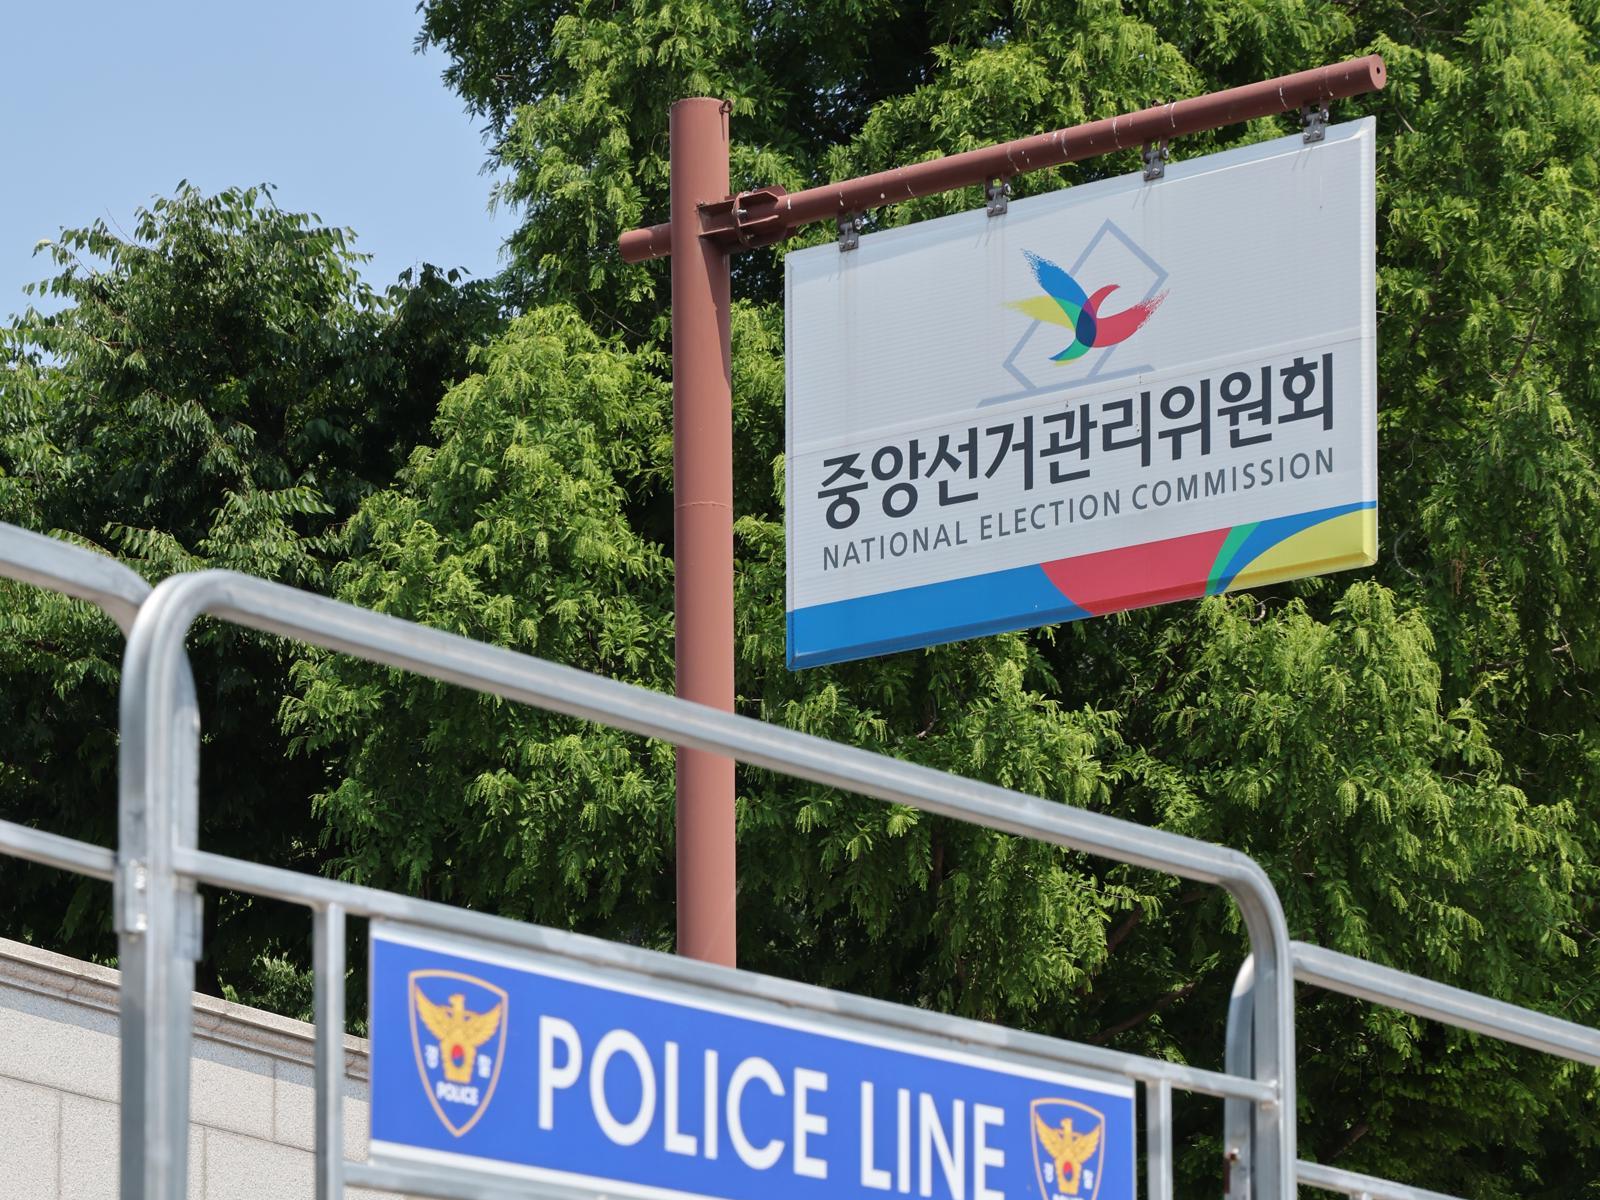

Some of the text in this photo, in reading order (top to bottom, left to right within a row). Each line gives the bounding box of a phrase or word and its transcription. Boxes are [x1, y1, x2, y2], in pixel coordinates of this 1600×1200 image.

[817, 352, 1334, 530] 중앙선거관리위원회
[822, 447, 1334, 571] NATIONAL ELECTION COMMISSION
[436, 1081, 479, 1106] POLICE
[538, 1015, 828, 1179] POLICE
